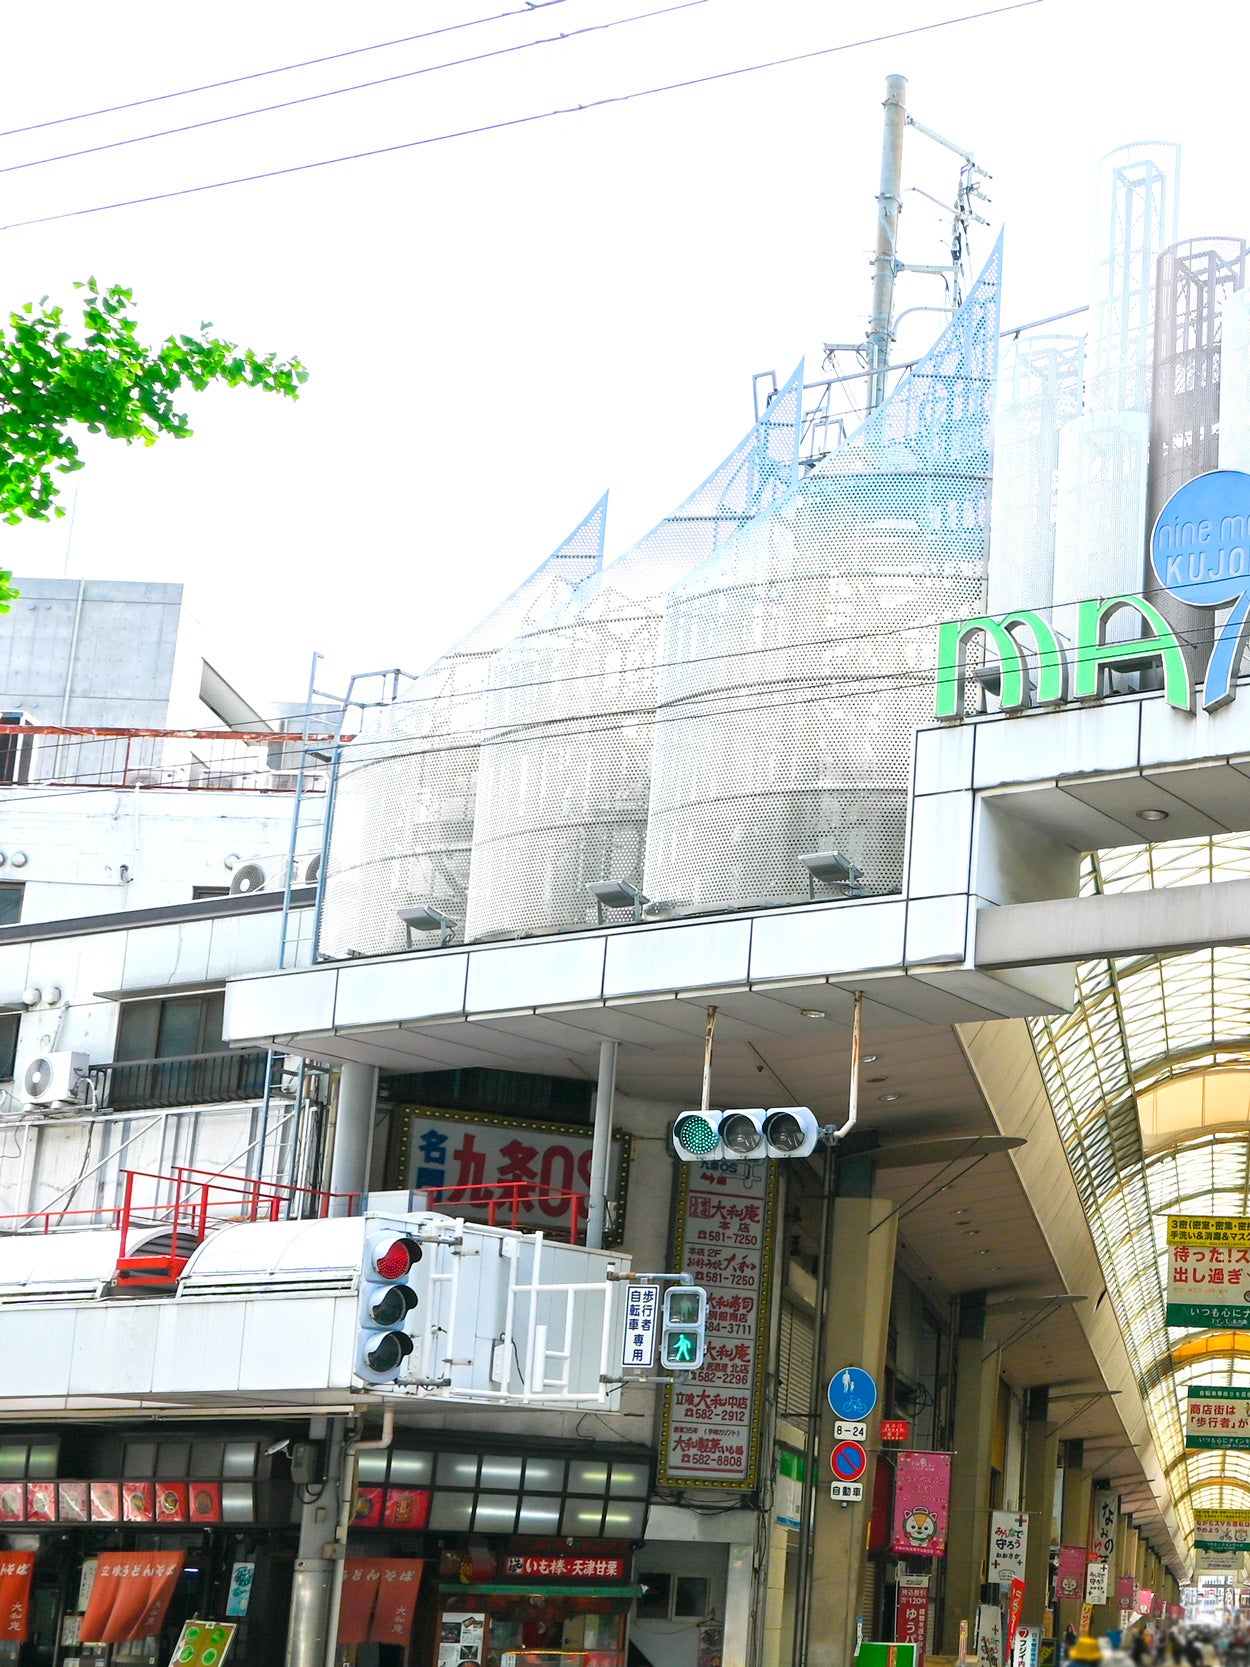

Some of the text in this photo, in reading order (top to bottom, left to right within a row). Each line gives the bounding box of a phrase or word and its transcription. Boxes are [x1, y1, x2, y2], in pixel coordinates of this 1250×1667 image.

[1157, 517, 1212, 551] nine
[708, 1230, 758, 1245] 581-7250
[706, 1271, 755, 1286] 581-7250
[1173, 1267, 1244, 1284] 出し過ぎ
[641, 1290, 654, 1332] 歩行者
[698, 1372, 748, 1385] 582-2296
[695, 1408, 746, 1422] 582-2912
[1190, 1404, 1236, 1416] 商店街は
[692, 1454, 742, 1467] 582-8808
[832, 1486, 862, 1497] 自動車
[995, 1538, 1021, 1550] 守ろう
